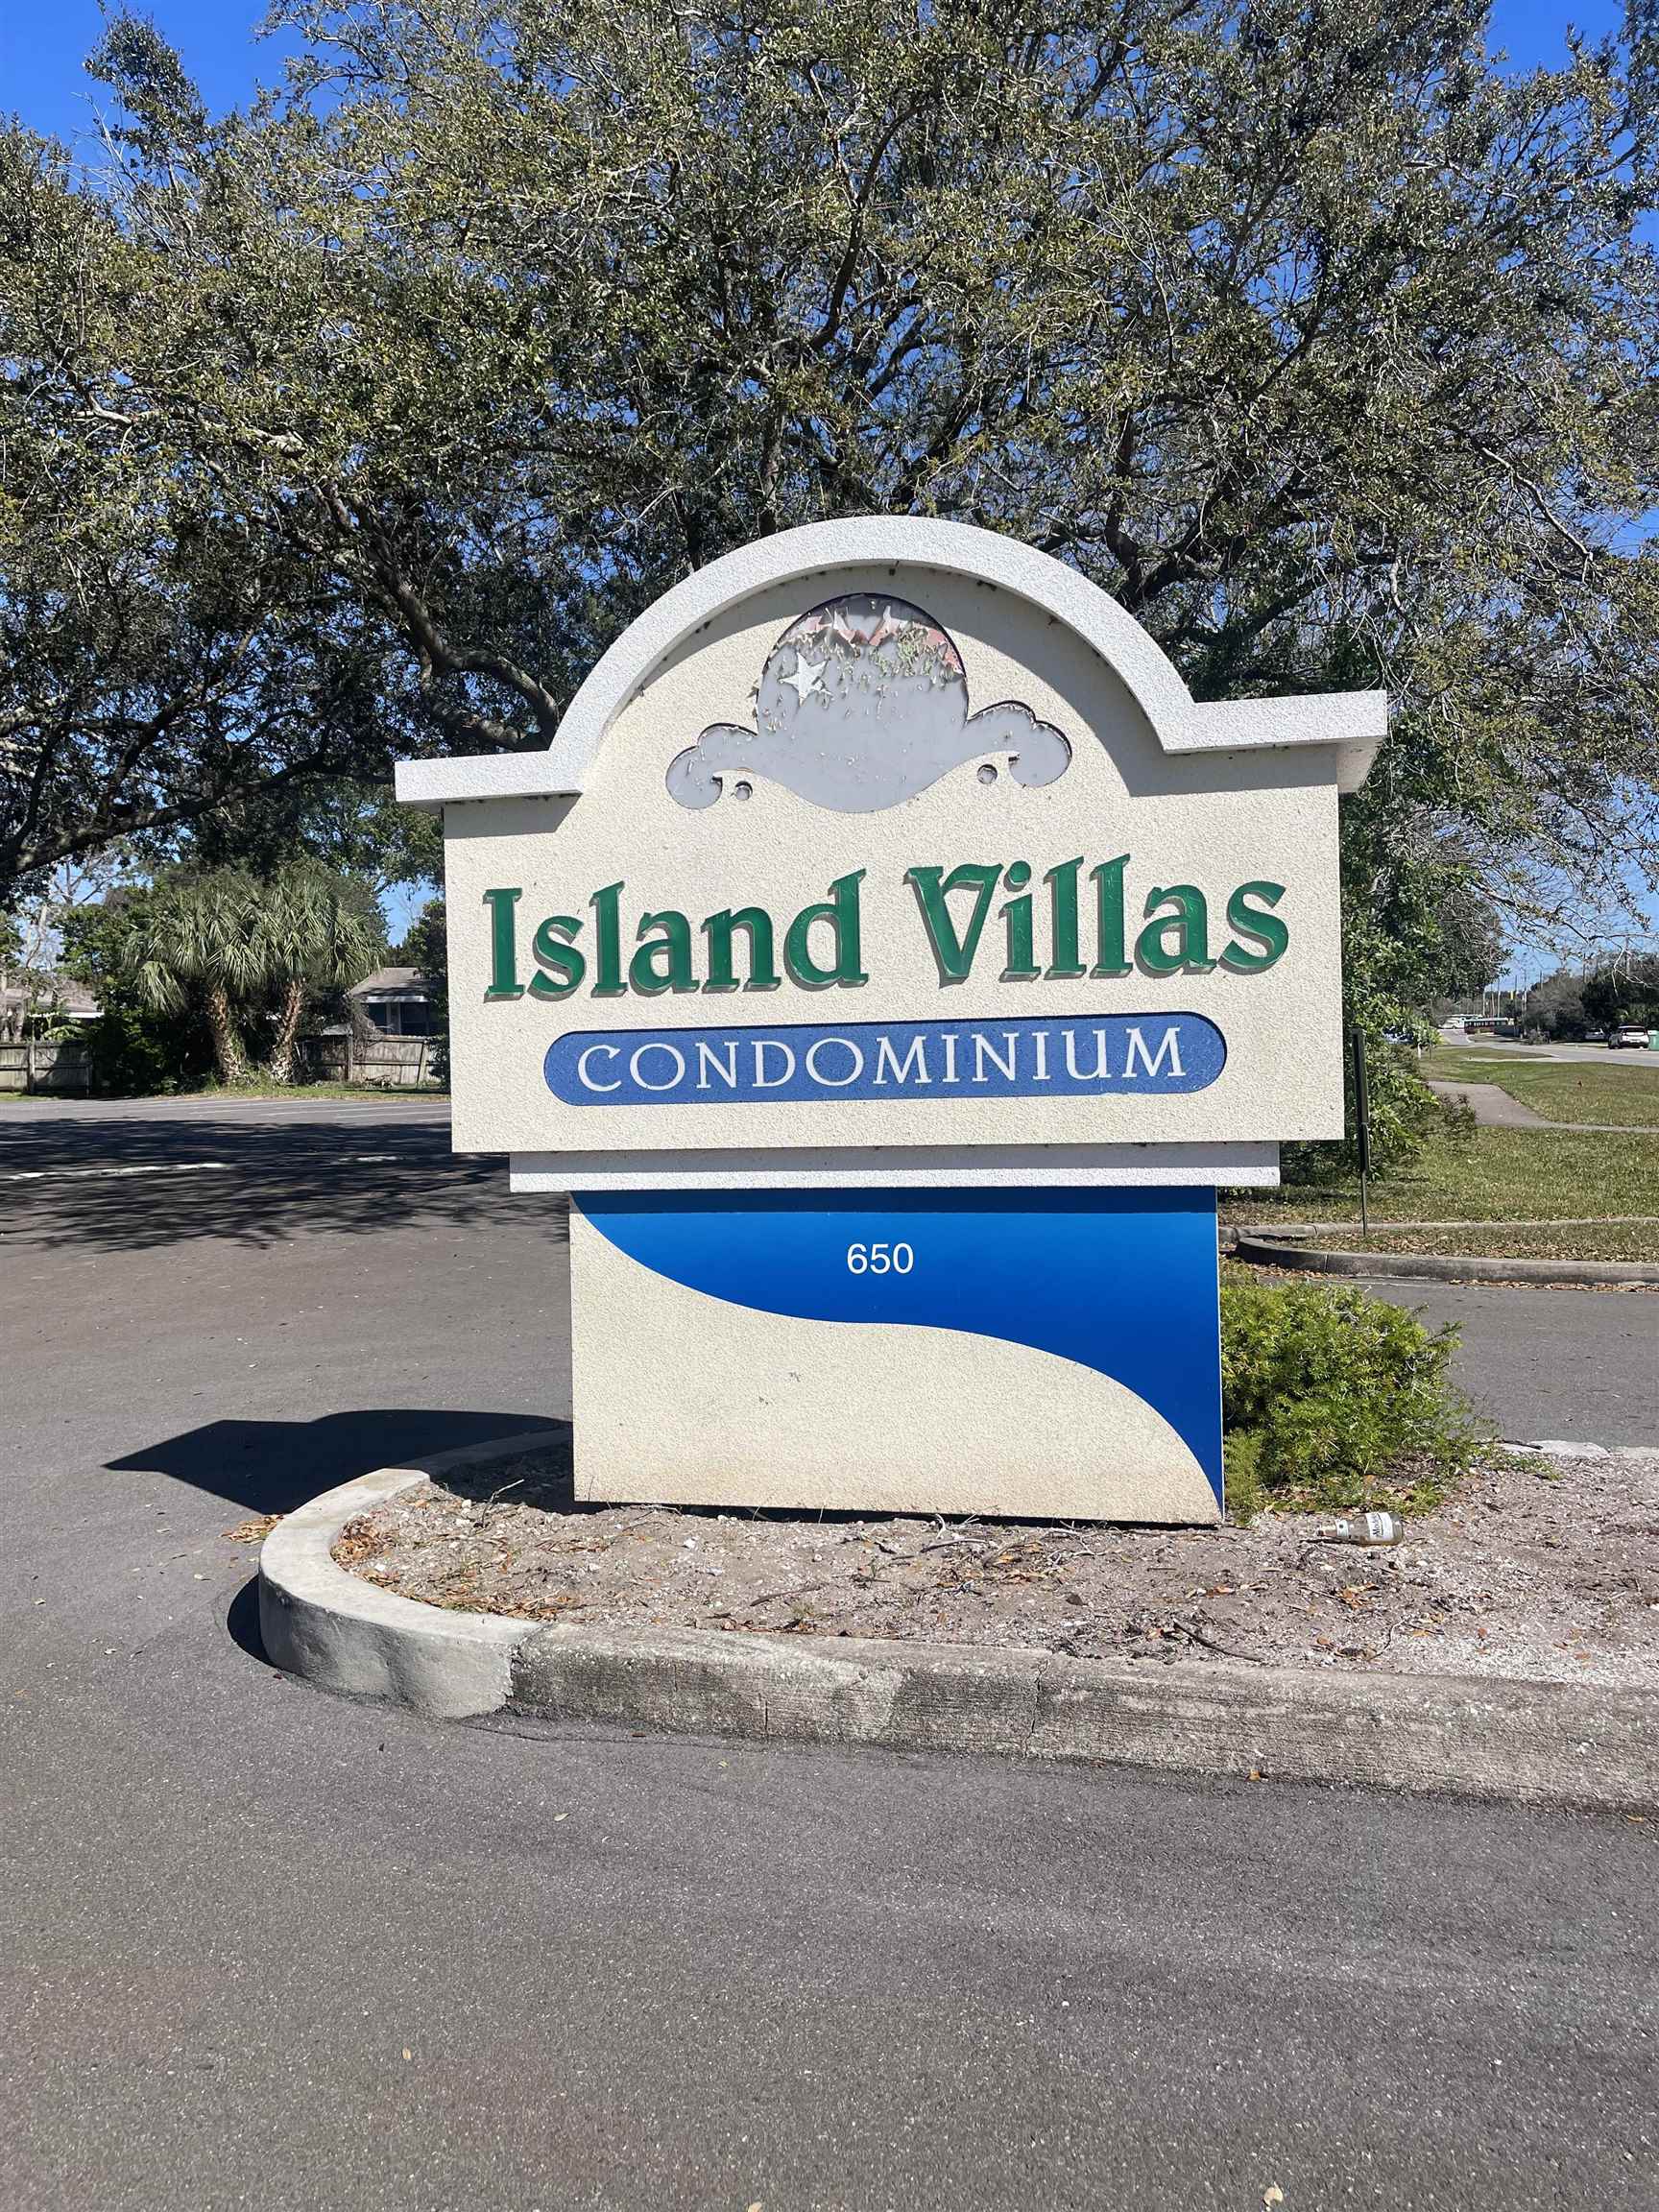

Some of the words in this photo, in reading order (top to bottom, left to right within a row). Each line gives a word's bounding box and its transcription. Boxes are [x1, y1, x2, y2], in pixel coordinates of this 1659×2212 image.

[483, 869, 867, 1000] Island
[905, 854, 1289, 986] Villas
[577, 1027, 1187, 1093] CONDOMINIUM
[847, 1242, 914, 1274] 650
